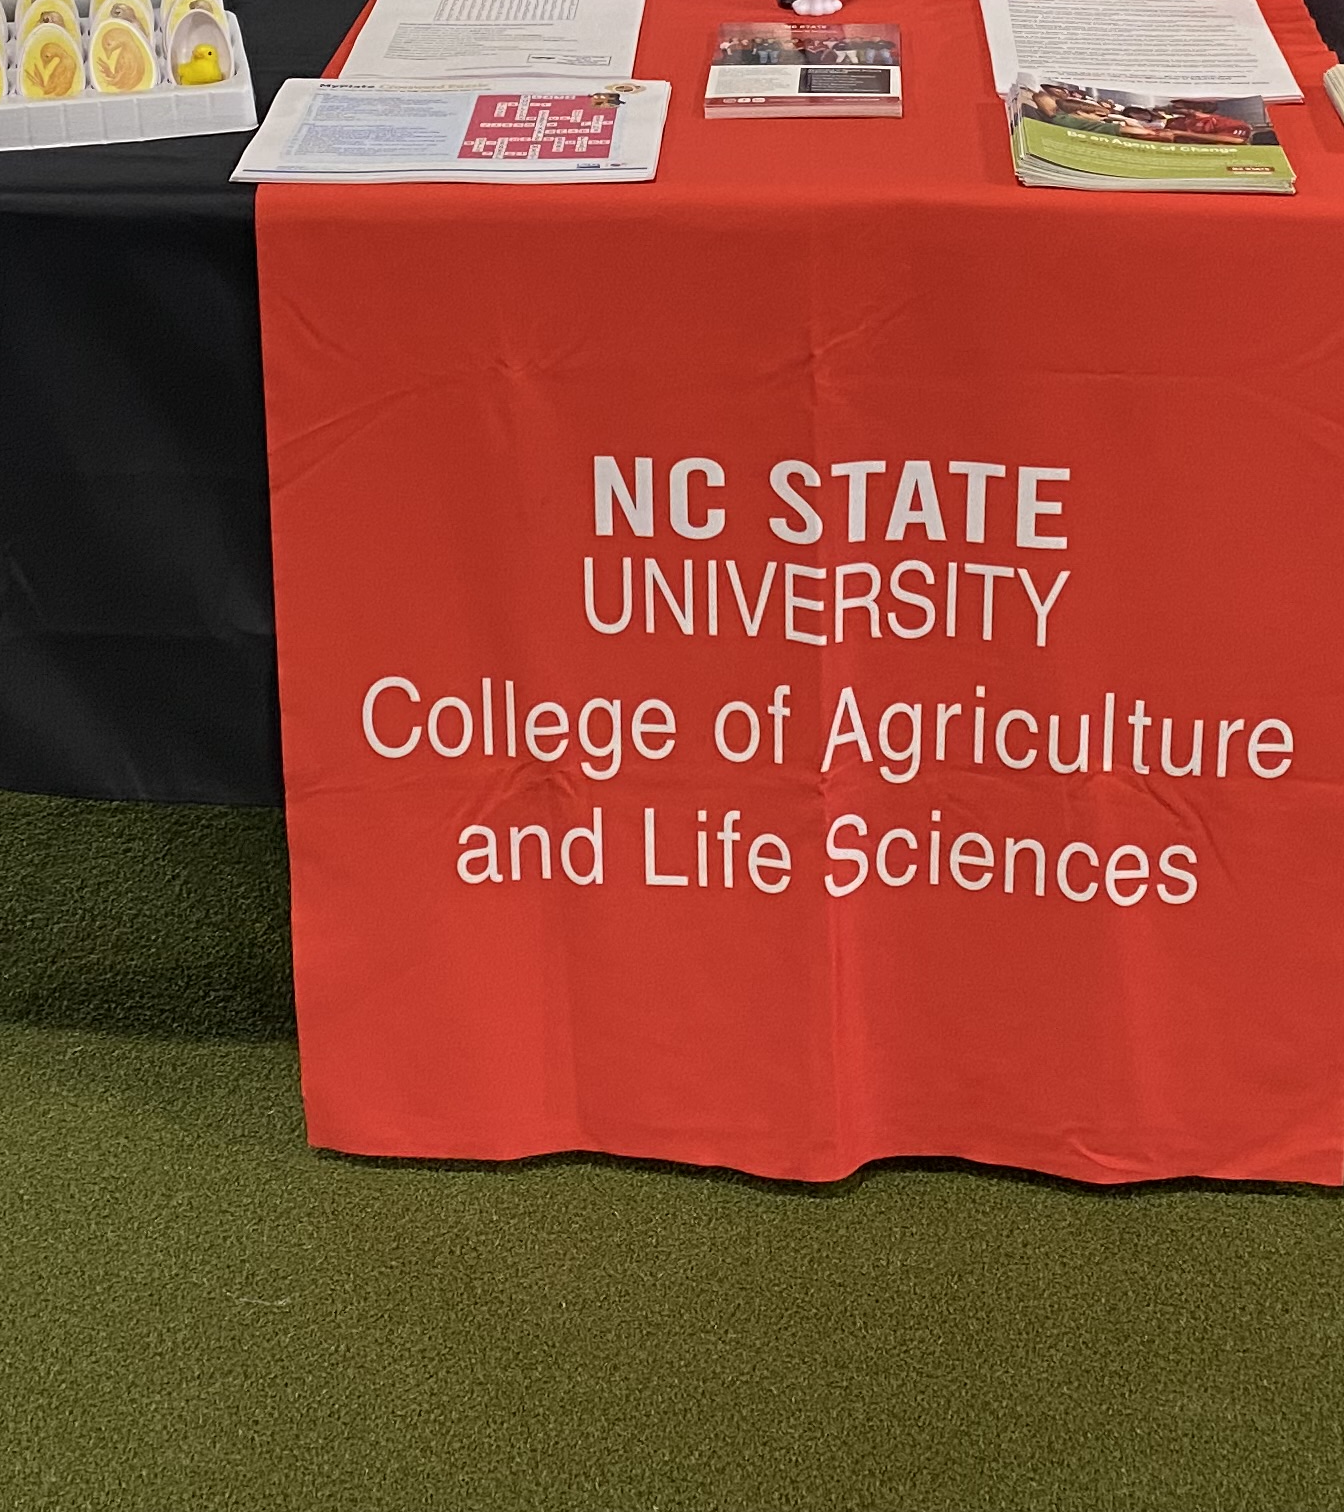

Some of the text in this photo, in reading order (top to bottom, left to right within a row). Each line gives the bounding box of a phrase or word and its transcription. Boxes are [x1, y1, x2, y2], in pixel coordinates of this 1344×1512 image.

[592, 455, 1071, 550] NC STATE
[583, 557, 1071, 648] UNIVERSITY
[360, 676, 1295, 783] College of Agriculture
[456, 808, 1199, 906] and Life Sciences
